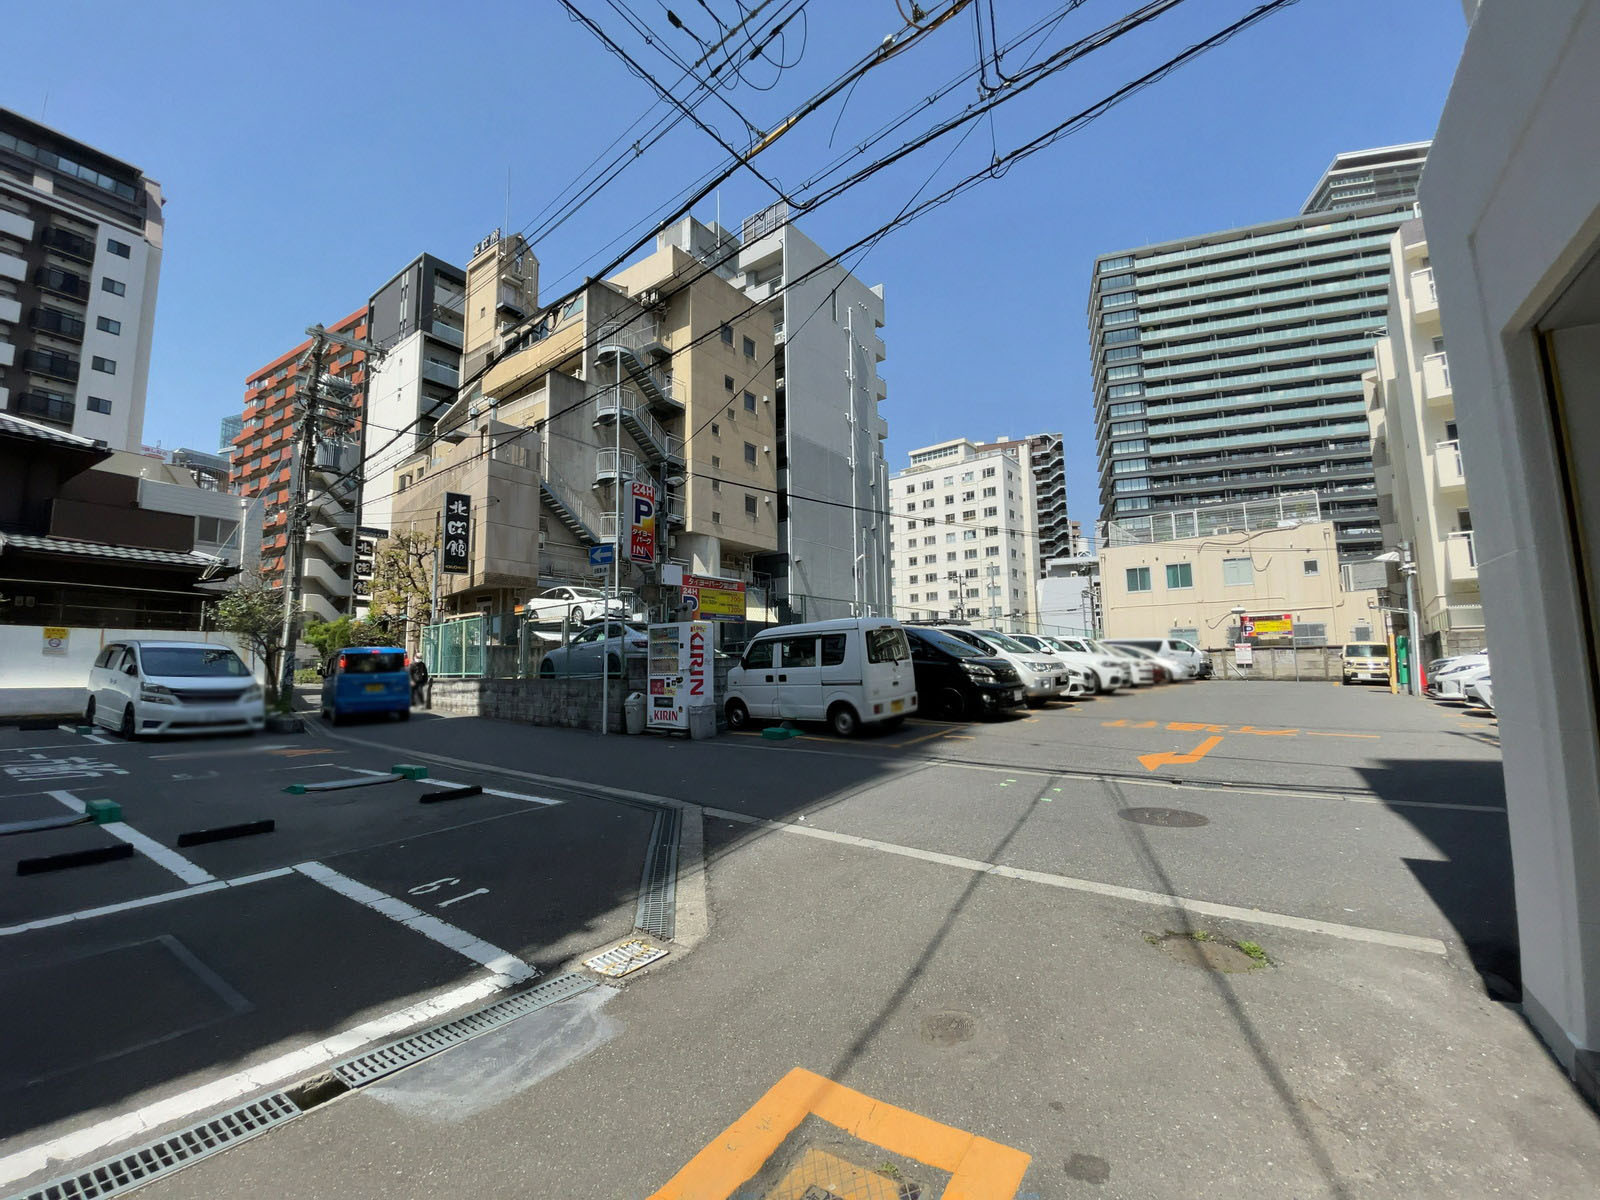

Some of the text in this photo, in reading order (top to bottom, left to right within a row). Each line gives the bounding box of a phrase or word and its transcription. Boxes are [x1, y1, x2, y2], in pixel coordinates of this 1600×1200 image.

[633, 483, 654, 497] 24H
[634, 497, 654, 526] P
[632, 529, 652, 537] タイヨー
[636, 537, 652, 545] パーク
[633, 546, 645, 555] IN
[682, 587, 698, 595] 24H
[690, 632, 704, 696] KIRIN
[653, 709, 678, 721] KIRIN
